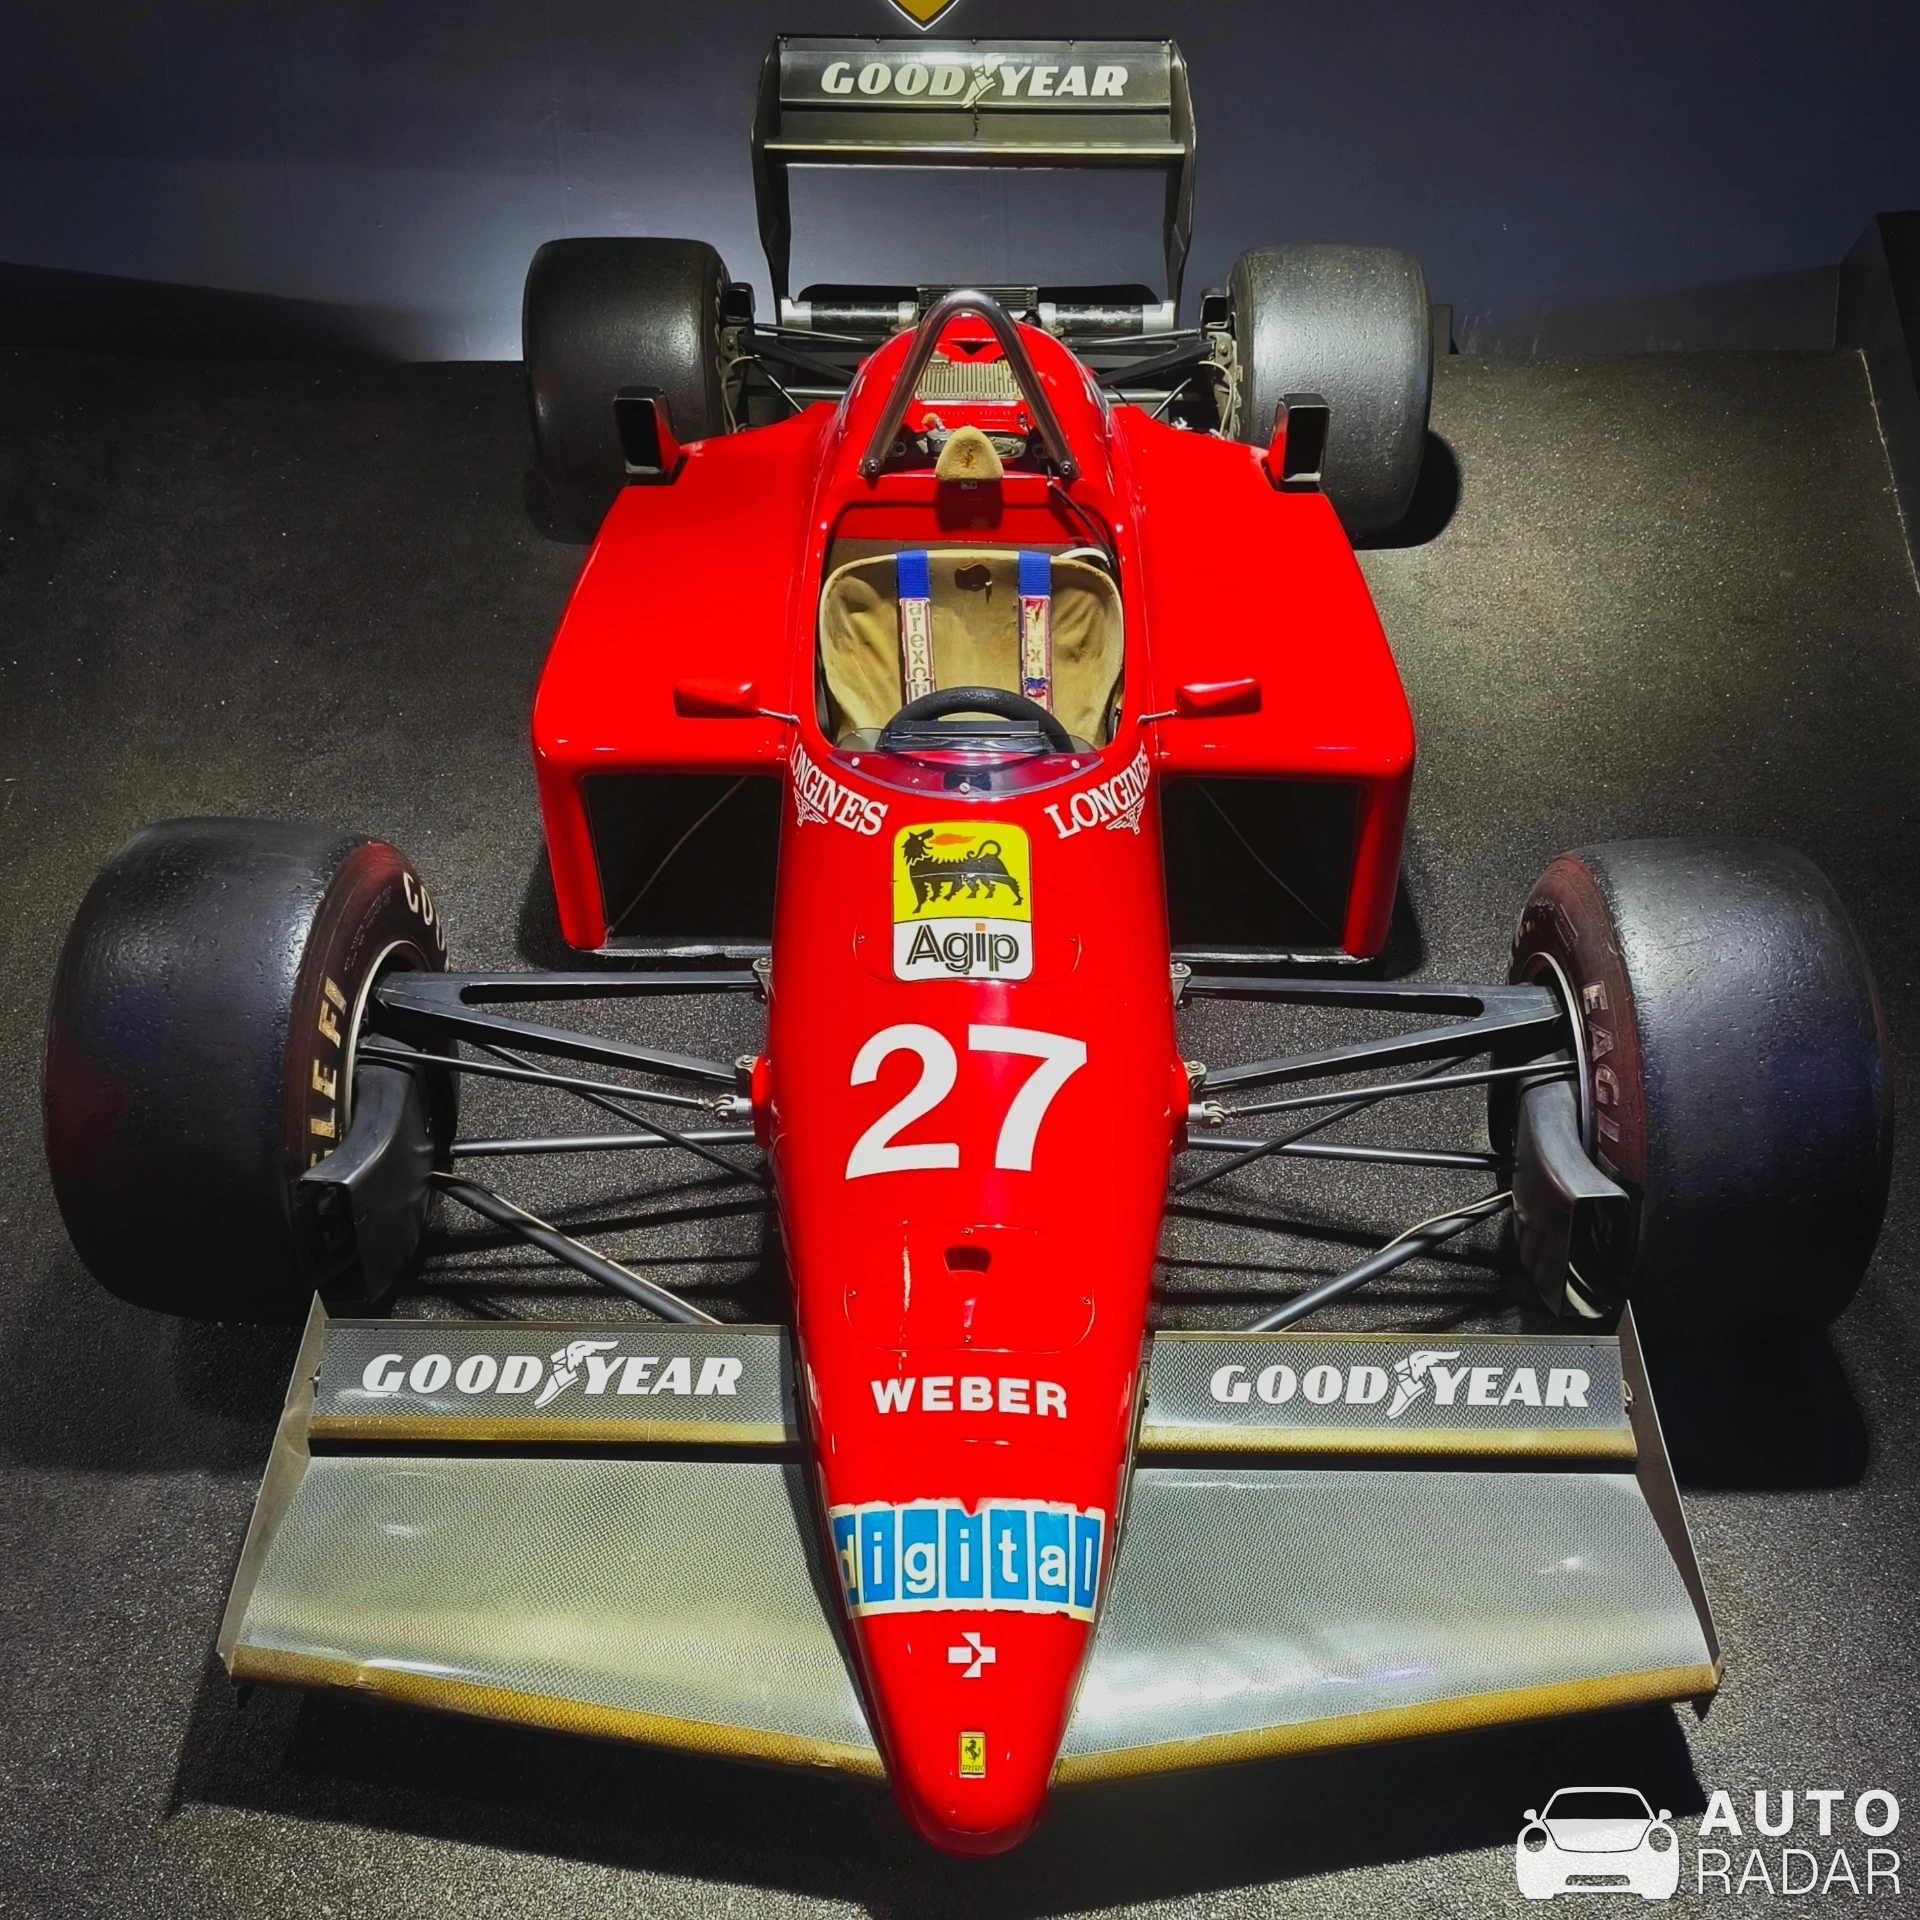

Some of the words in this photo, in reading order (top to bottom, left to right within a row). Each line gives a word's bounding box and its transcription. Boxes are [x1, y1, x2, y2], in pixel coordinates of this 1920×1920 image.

[403, 871, 450, 973] GOO
[906, 922, 1020, 976] Agip
[845, 1022, 1088, 1181] 27
[871, 1376, 1067, 1418] WEBER
[840, 1529, 1092, 1594] digital
